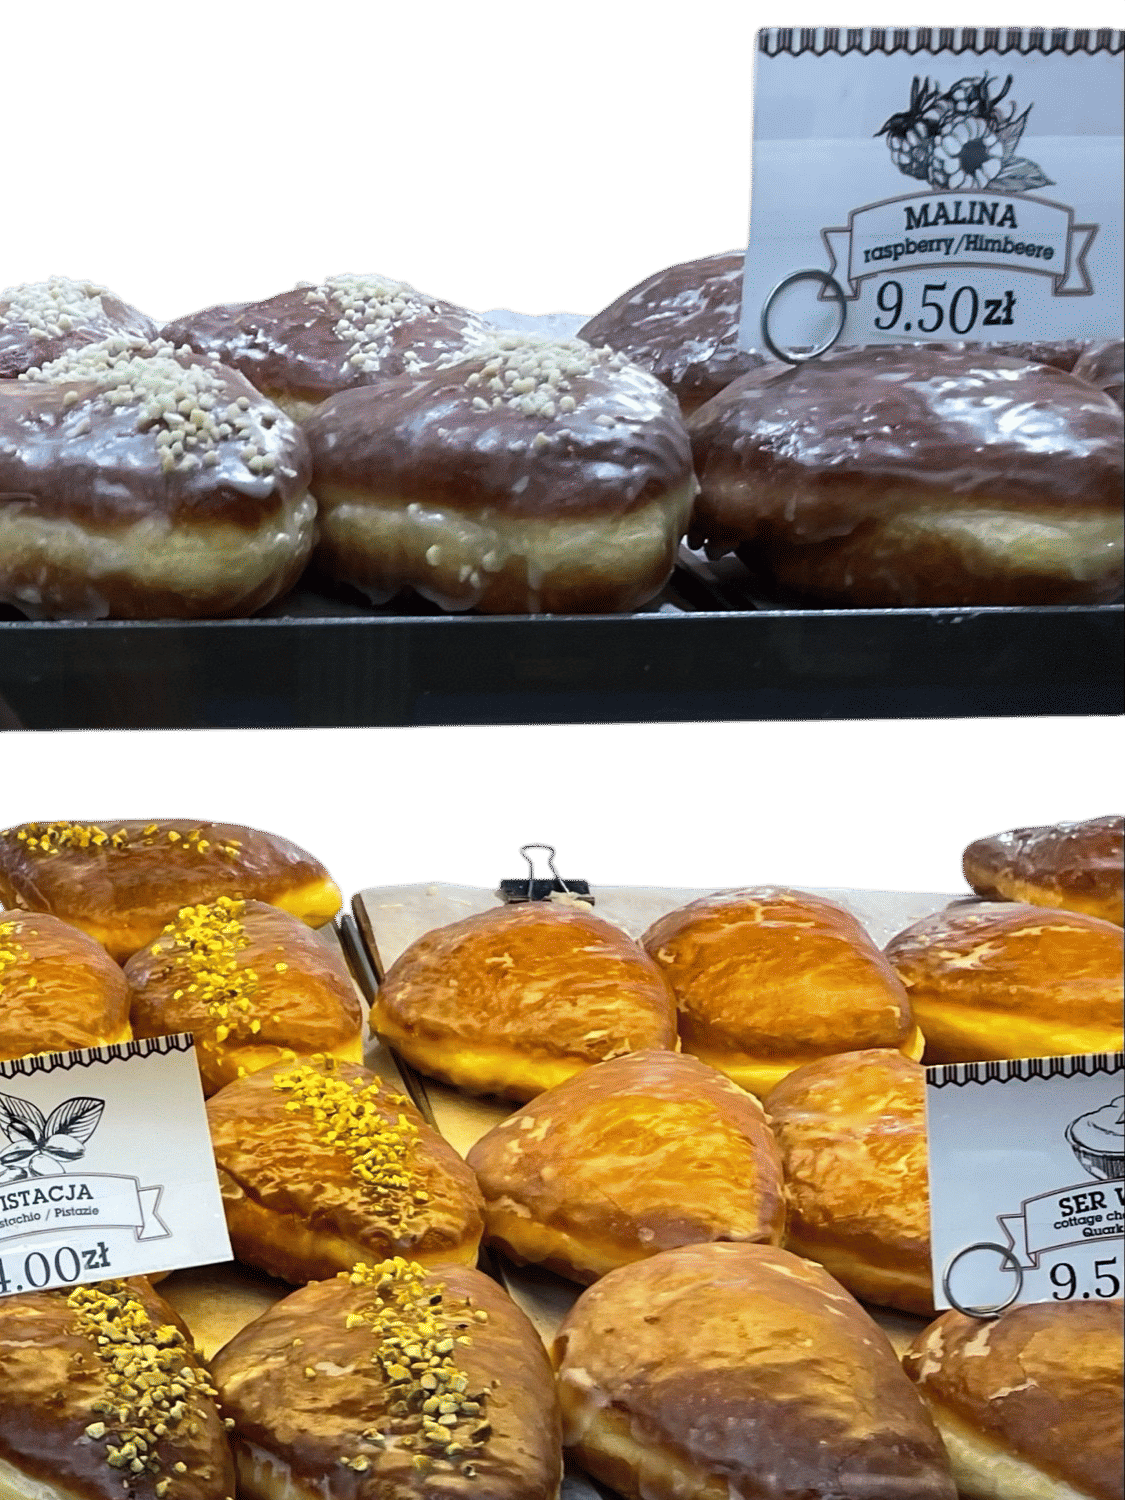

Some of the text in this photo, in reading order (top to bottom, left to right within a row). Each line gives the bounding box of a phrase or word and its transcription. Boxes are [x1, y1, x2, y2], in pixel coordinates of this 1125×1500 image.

[904, 201, 1018, 230] MALINA
[54, 1205, 99, 1218] Pistazie
[1059, 1191, 1107, 1217] SER
[1054, 1211, 1125, 1229] cottage ch
